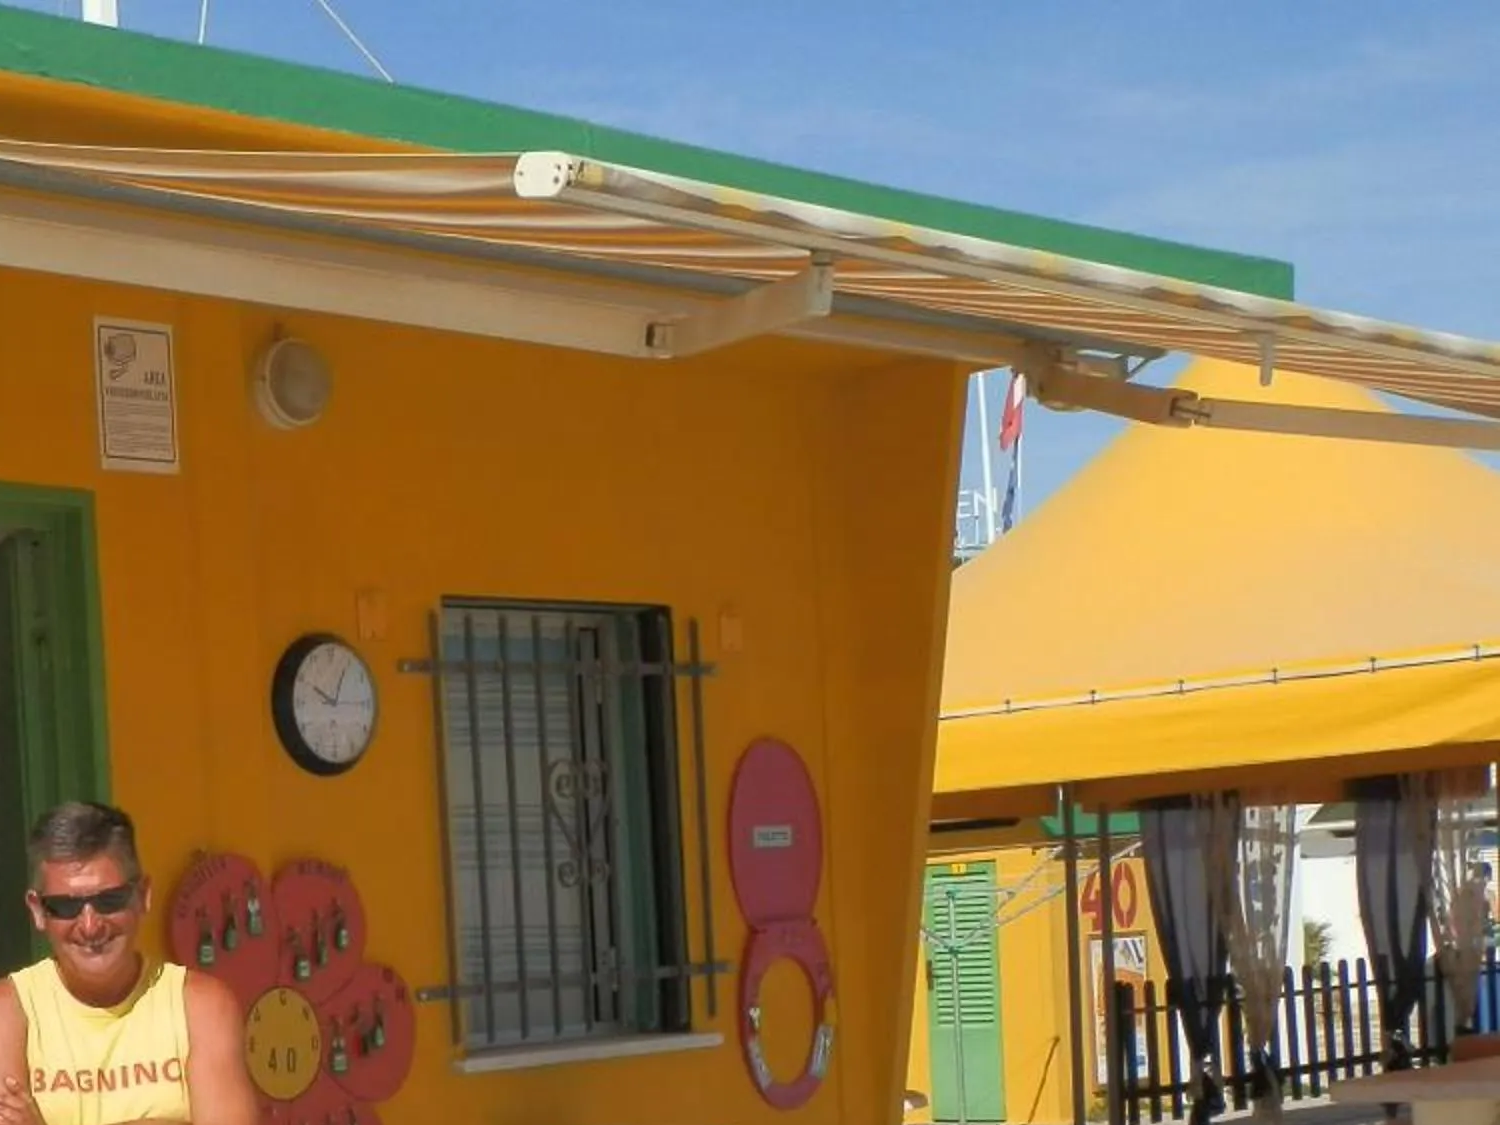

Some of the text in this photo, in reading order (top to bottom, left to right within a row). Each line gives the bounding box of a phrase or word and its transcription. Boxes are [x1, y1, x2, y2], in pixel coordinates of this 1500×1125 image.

[1080, 861, 1137, 932] 40
[33, 1057, 183, 1094] BAGNINO
[267, 1047, 297, 1074] 40
